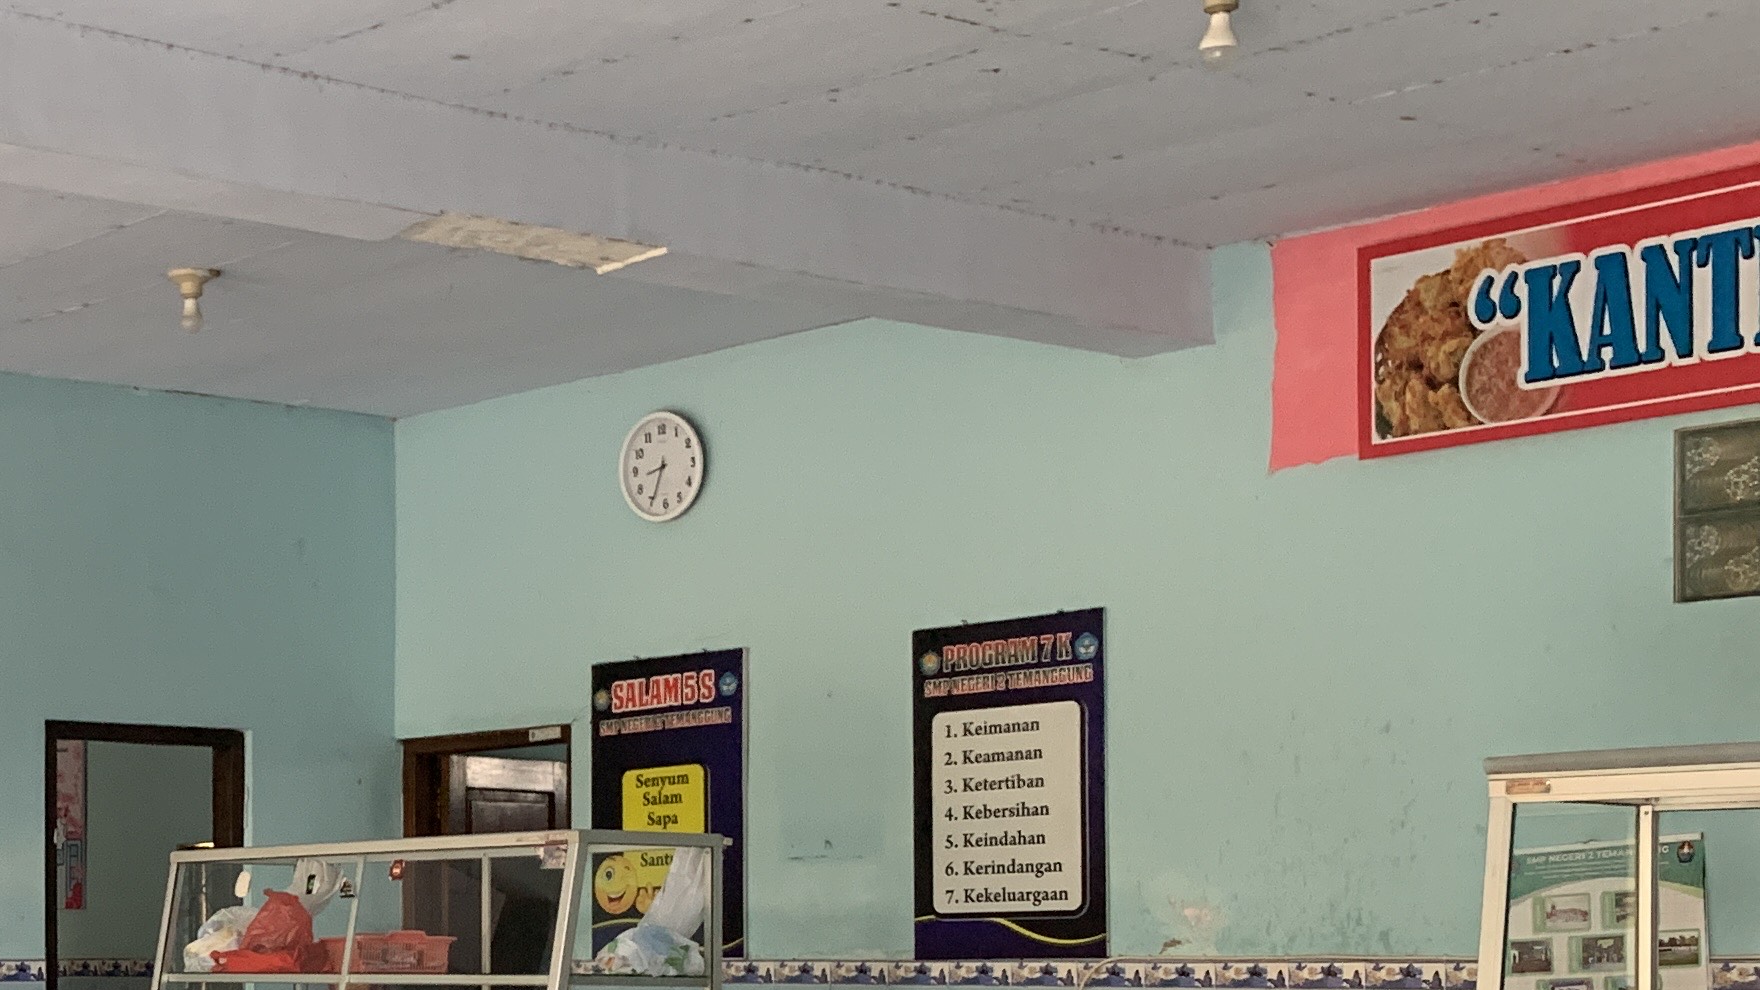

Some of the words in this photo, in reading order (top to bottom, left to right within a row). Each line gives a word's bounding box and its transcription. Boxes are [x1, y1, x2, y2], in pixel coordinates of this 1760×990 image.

[1475, 225, 1760, 383] “KANT
[644, 432, 652, 444] 11
[657, 423, 667, 436] 12
[685, 437, 691, 449] 2
[635, 448, 644, 460] 10
[690, 456, 696, 468] 3
[632, 466, 638, 478] 9
[637, 483, 643, 496] 8
[685, 475, 691, 488] 4
[648, 495, 655, 508] 7
[663, 498, 669, 510] 6
[676, 491, 682, 504] 5
[942, 637, 1039, 673] PROGRAM
[1040, 635, 1054, 662] 7
[1056, 632, 1072, 660] K
[924, 679, 950, 697] SMP
[951, 675, 993, 694] NEGERI
[1008, 663, 1093, 689] TEMANGGUNG
[612, 674, 681, 712] SALAM
[665, 708, 732, 729] TEMANGGUNG
[945, 724, 958, 738] 1.
[962, 720, 1040, 737] Keimanan
[944, 751, 958, 766] 2.
[962, 747, 1044, 765] Keamanan
[635, 773, 690, 790] Senyum
[943, 779, 958, 795] 3.
[962, 773, 1045, 792] Ketertiban
[642, 791, 684, 807] Salam
[647, 811, 679, 829] Sapa
[944, 806, 958, 822] 4.
[962, 801, 1050, 820] Kebersihan
[944, 834, 959, 850] 5.
[962, 830, 1046, 848] Keindahan
[944, 861, 959, 877] 6.
[962, 858, 1063, 879] Kerindangan
[945, 889, 959, 904] 7.
[963, 887, 1070, 907] Kekeluargaan
